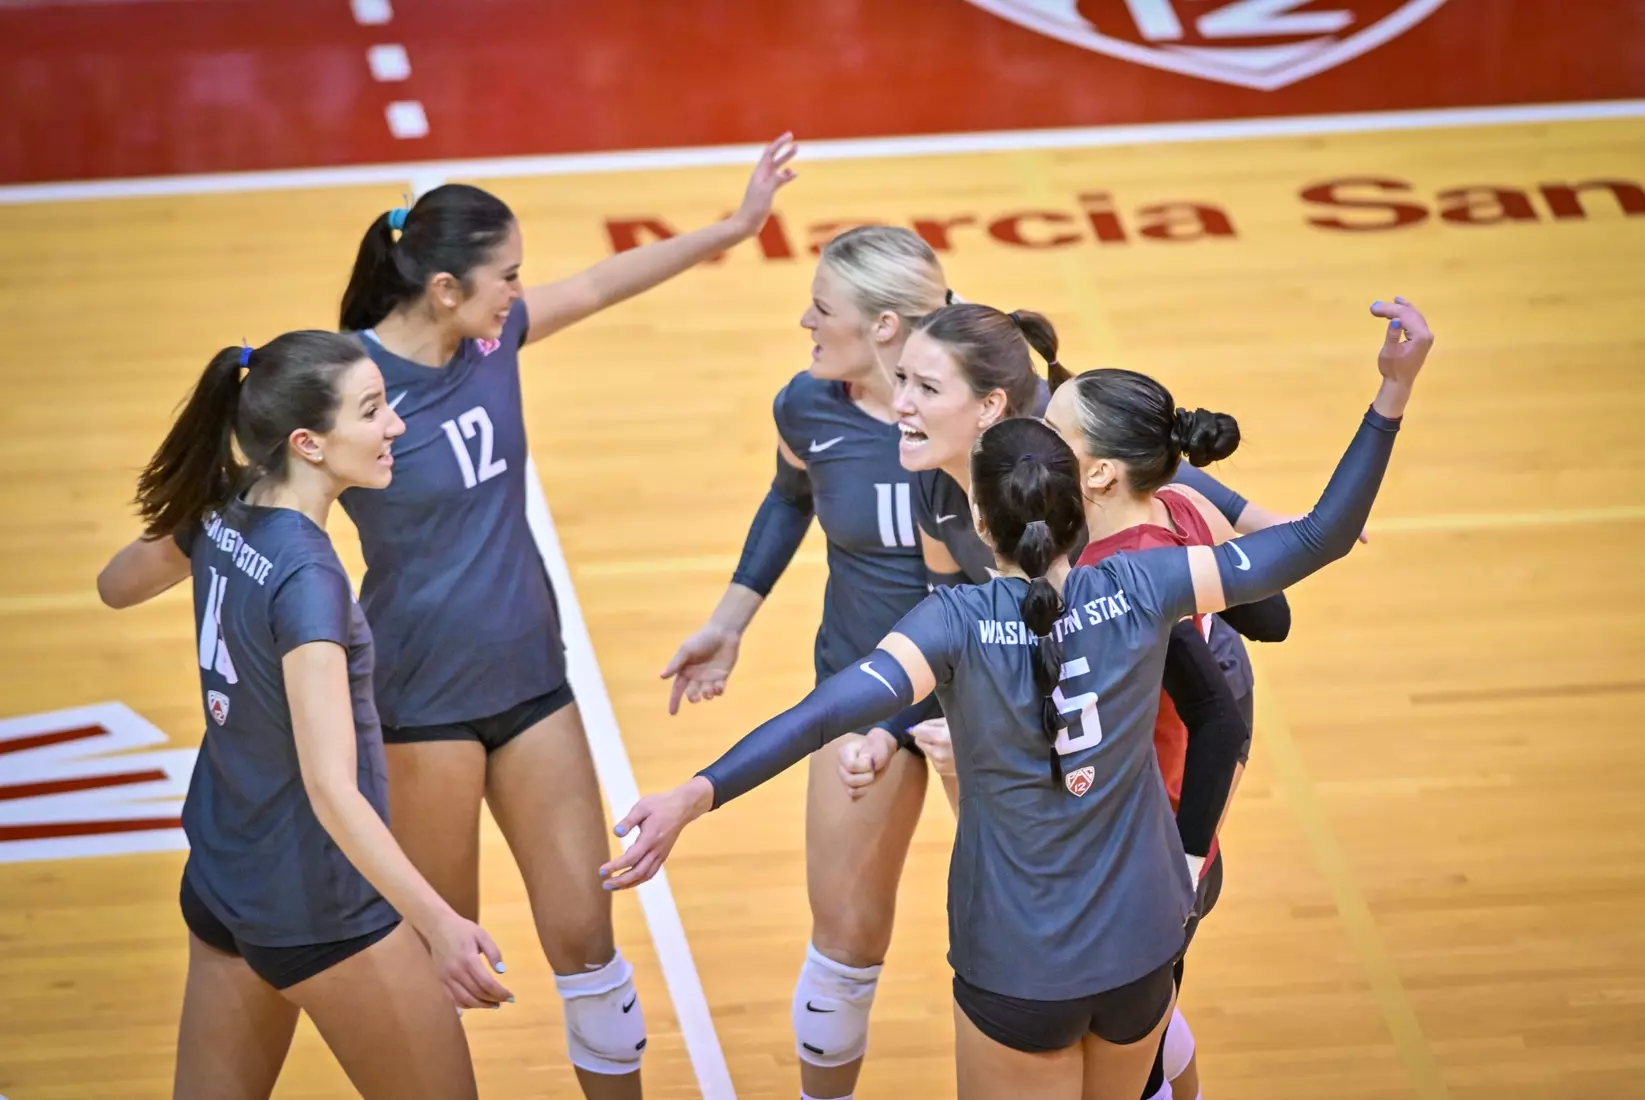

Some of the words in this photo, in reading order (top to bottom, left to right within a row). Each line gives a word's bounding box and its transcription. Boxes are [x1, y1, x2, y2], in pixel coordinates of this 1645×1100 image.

[440, 405, 508, 489] 12
[873, 482, 916, 547] 11
[235, 543, 273, 586] STATE
[1083, 589, 1132, 626] STAT
[1051, 656, 1103, 756] 5
